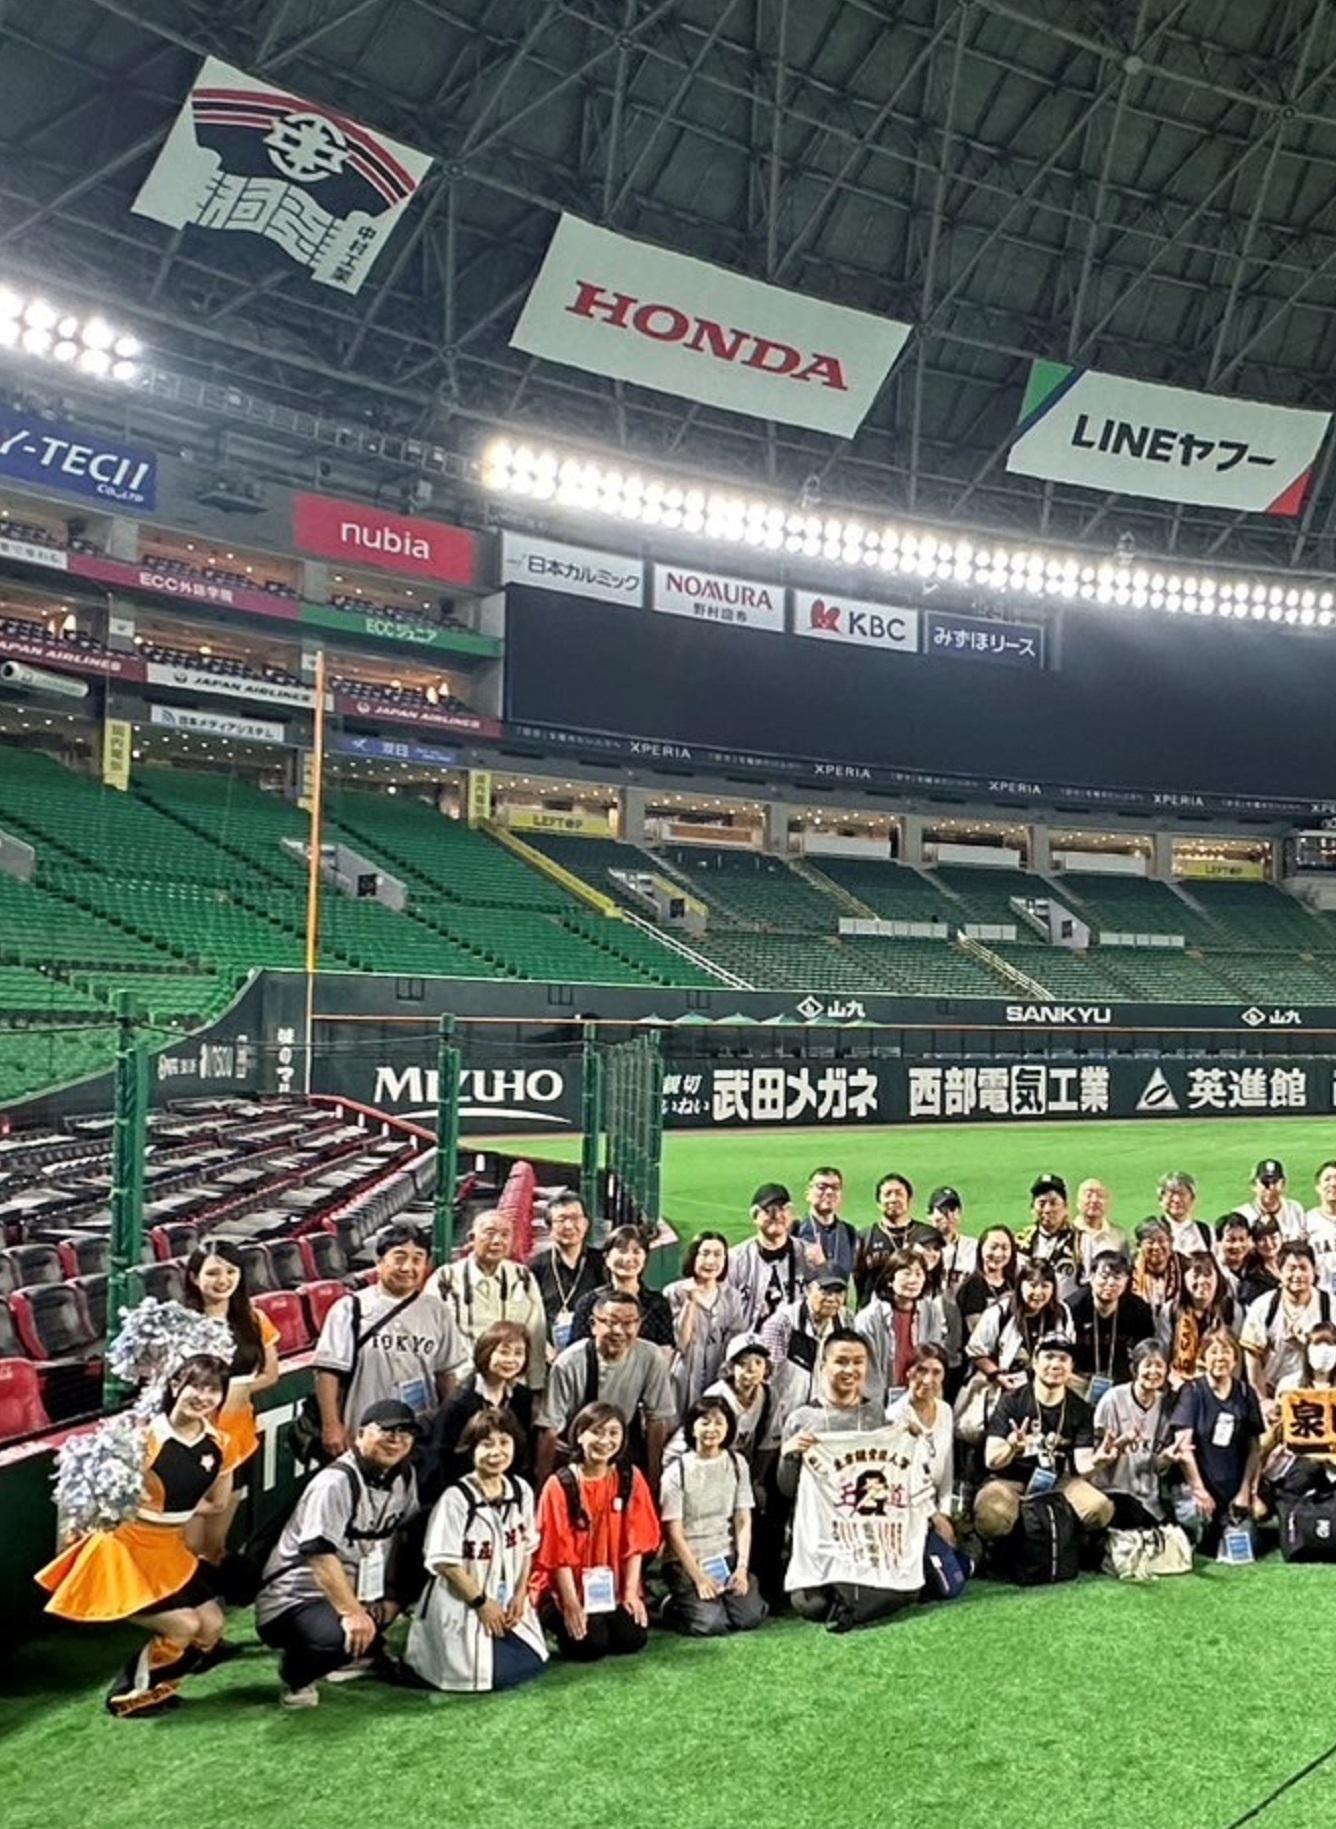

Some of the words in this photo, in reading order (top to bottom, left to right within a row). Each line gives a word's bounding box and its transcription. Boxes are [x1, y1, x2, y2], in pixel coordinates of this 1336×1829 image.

[565, 280, 848, 391] HONDA
[1071, 414, 1276, 471] LINEヤフー
[341, 522, 430, 559] nubia
[528, 555, 639, 591] 日本カルミック
[666, 572, 773, 610] NOMURA
[848, 611, 906, 641] KBC
[934, 626, 1036, 657] みずほリース
[46, 650, 121, 671] AIRLINES
[193, 678, 241, 691] JAPAN
[244, 686, 310, 702] AIRLINES
[375, 705, 418, 719] JAPAN
[420, 713, 480, 729] AIRLINES
[630, 741, 691, 759] XPERIA
[814, 764, 871, 779] XPERIA
[988, 780, 1042, 795] XPERIA
[1152, 794, 1204, 806] XPERIA
[828, 1000, 866, 1018] 山九
[1006, 1006, 1111, 1024] SANKYU
[1269, 1009, 1301, 1024] 山九
[712, 1067, 878, 1121] 武田メガネ
[909, 1065, 1110, 1116] 西部電気工業
[1187, 1067, 1307, 1110] 英進館
[371, 1333, 435, 1356] TOKYO
